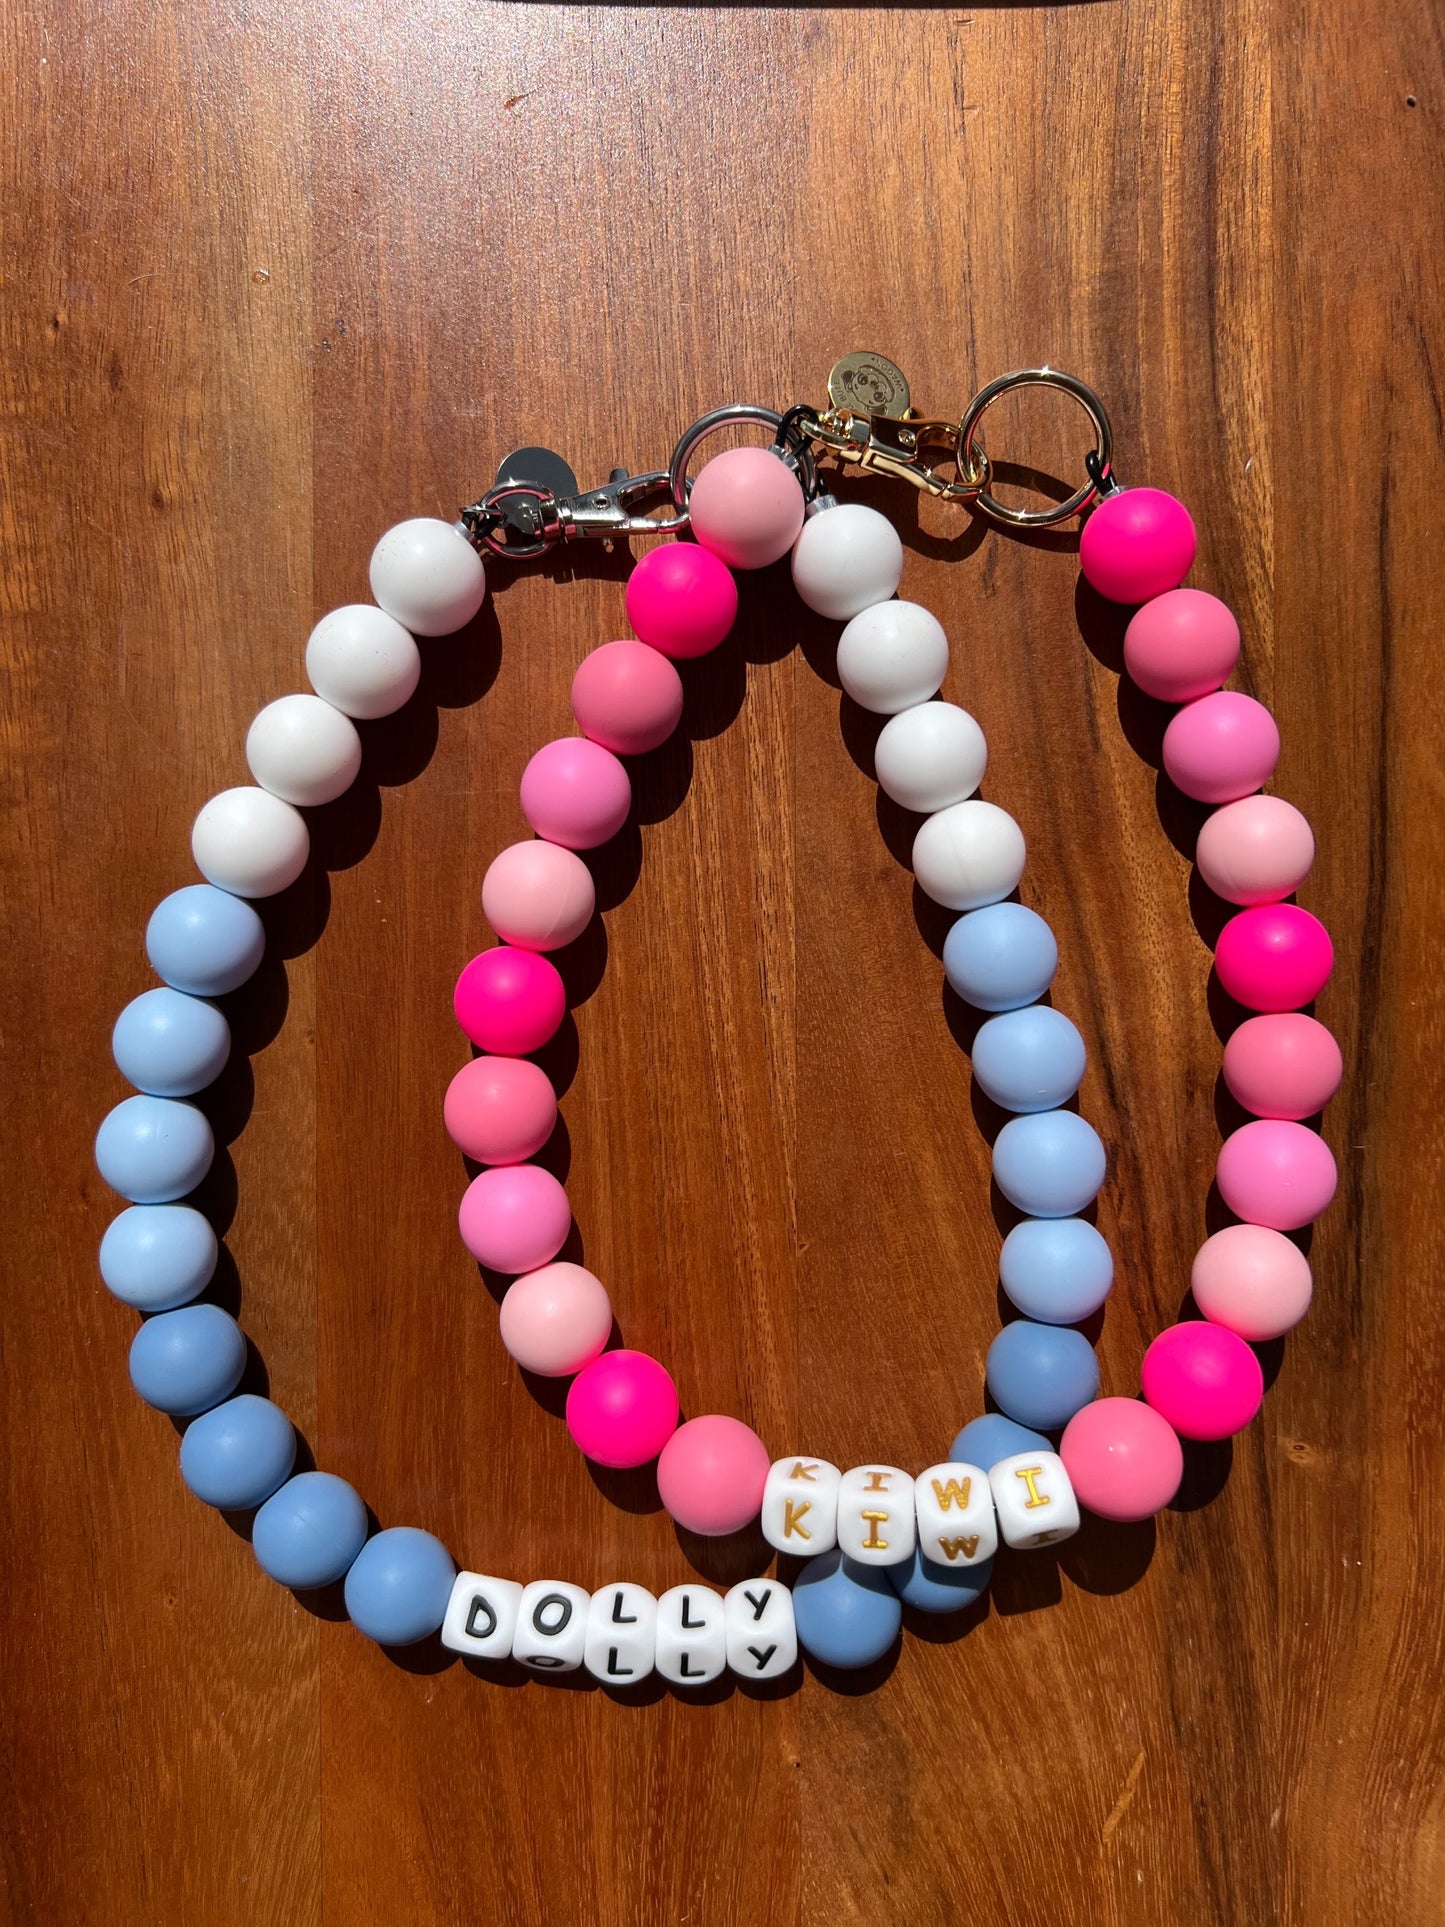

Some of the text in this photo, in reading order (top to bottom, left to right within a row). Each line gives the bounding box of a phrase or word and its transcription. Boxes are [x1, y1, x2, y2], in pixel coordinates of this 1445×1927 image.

[875, 359, 902, 389] WAGON
[783, 1466, 1051, 1549] KIWI
[465, 1589, 772, 1638] DOLLY
